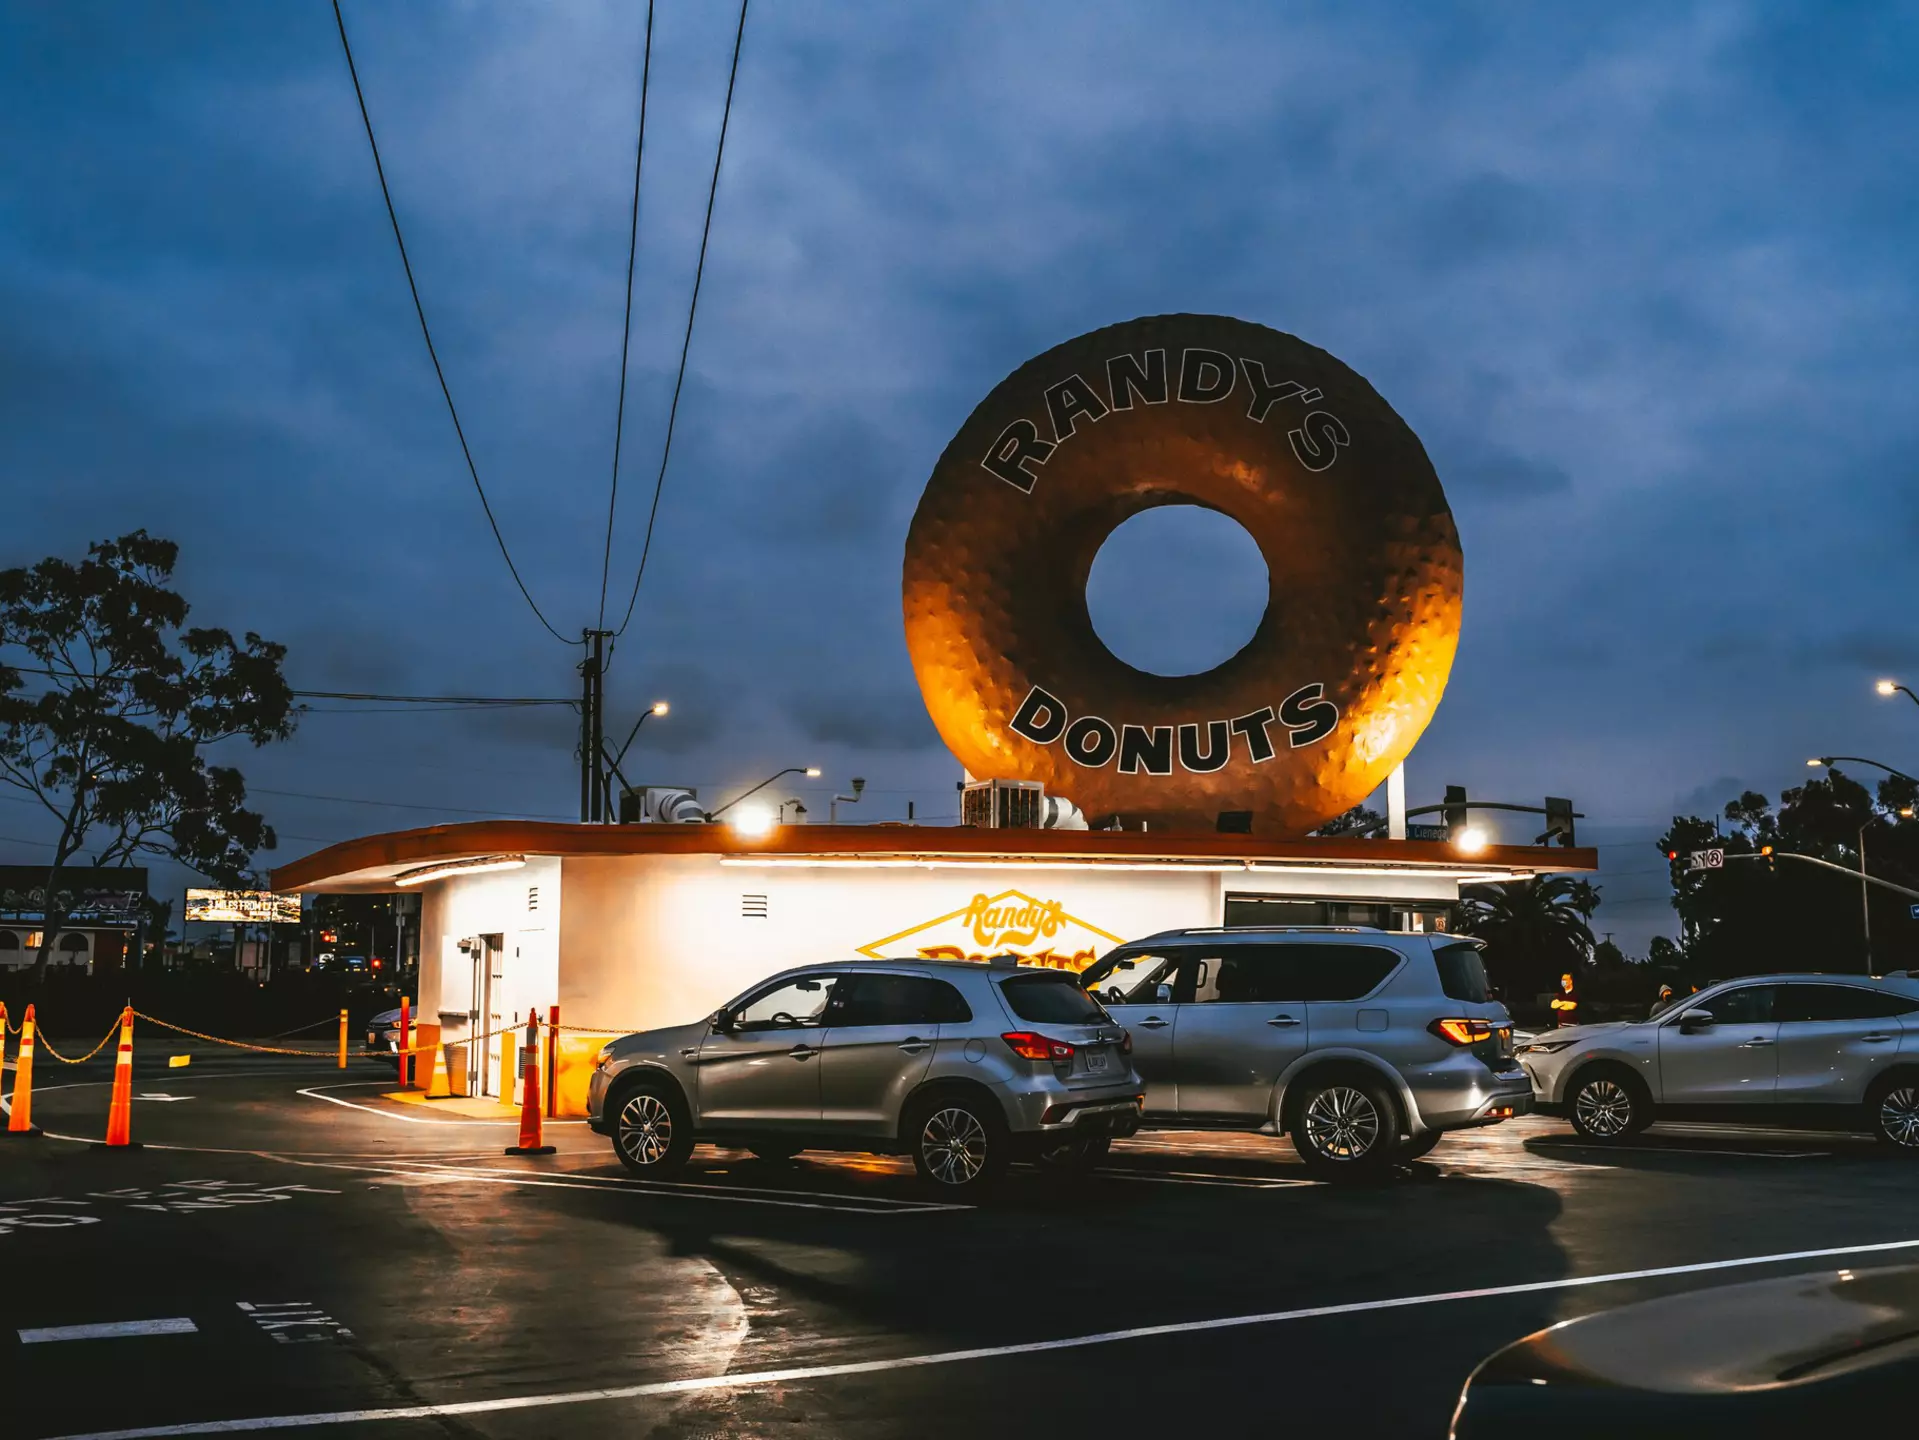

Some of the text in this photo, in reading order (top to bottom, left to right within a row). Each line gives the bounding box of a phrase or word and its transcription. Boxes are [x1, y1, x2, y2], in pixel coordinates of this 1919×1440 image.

[980, 348, 1351, 494] RANDY'S
[1009, 683, 1340, 775] DONUTS
[215, 899, 238, 909] MILES
[240, 900, 260, 910] FROM
[963, 893, 1066, 949] Randy's
